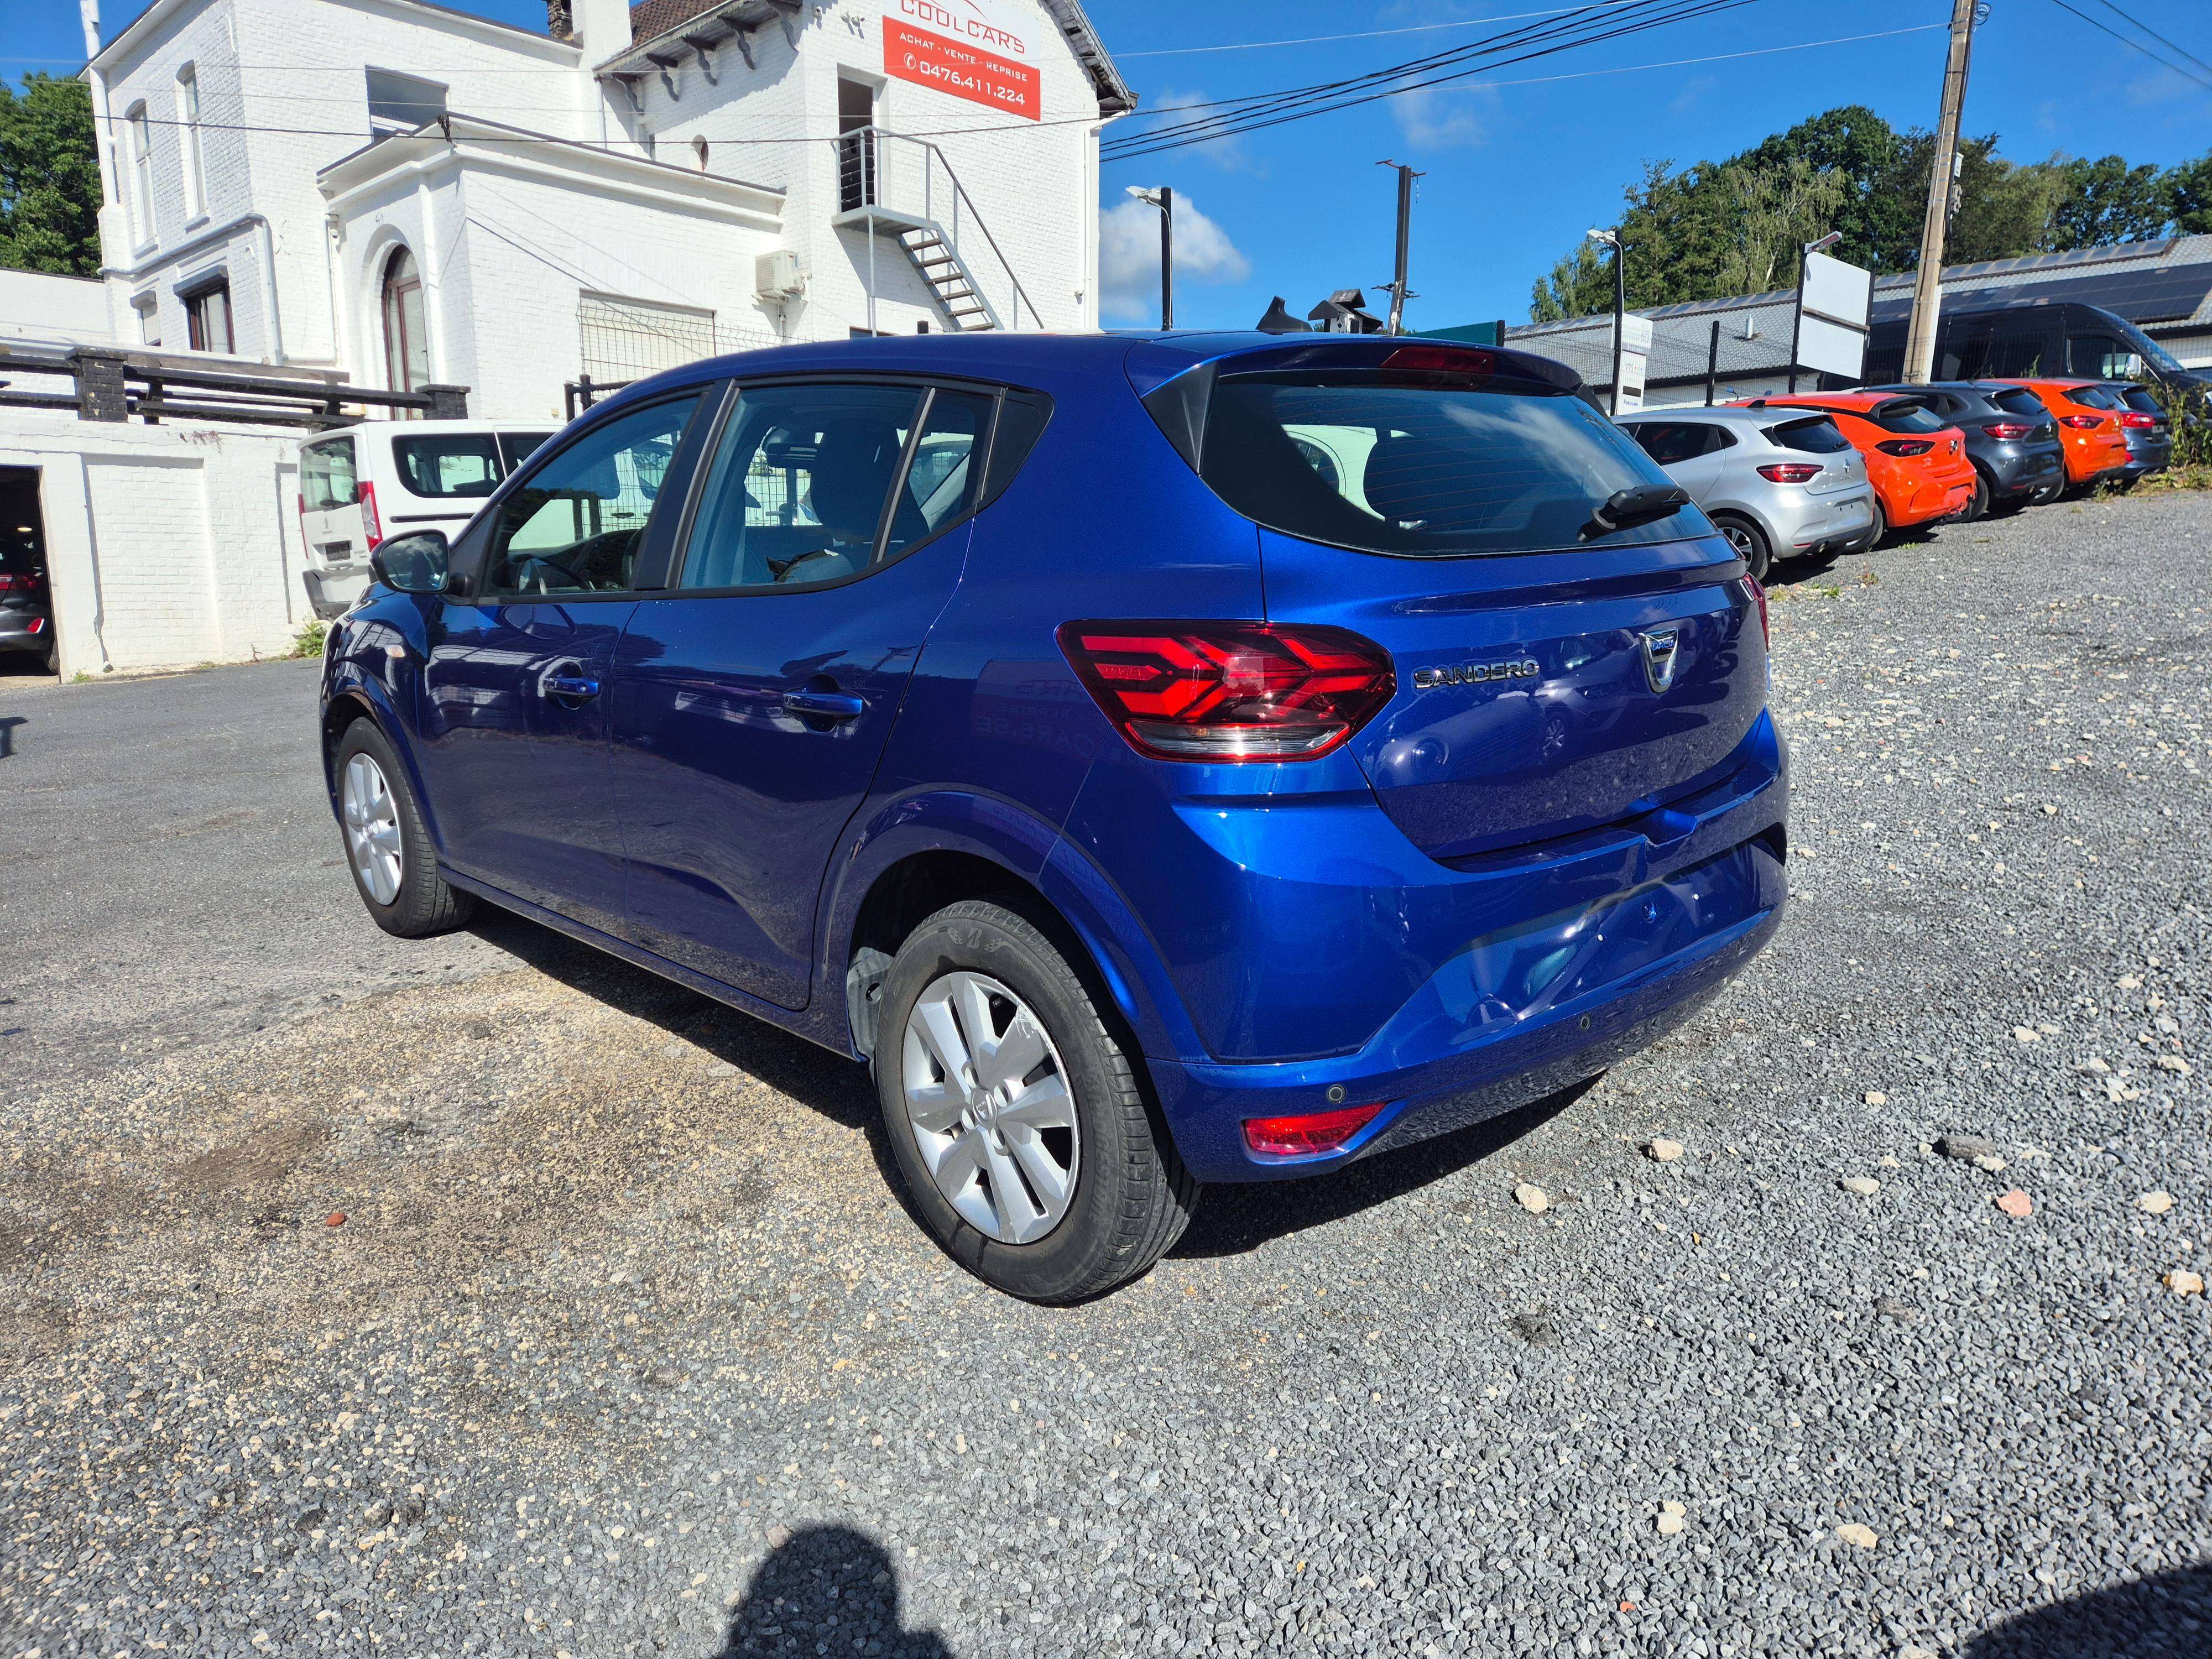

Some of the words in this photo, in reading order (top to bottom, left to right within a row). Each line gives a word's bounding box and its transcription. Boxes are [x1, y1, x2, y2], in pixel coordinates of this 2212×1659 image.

[901, 0, 1025, 54] COOLCARS
[900, 32, 935, 50] ACHAT
[944, 46, 977, 64] VENTE
[986, 61, 1027, 81] REPRISE
[920, 60, 1025, 105] 0476.411.224
[1414, 659, 1540, 688] SANDERO
